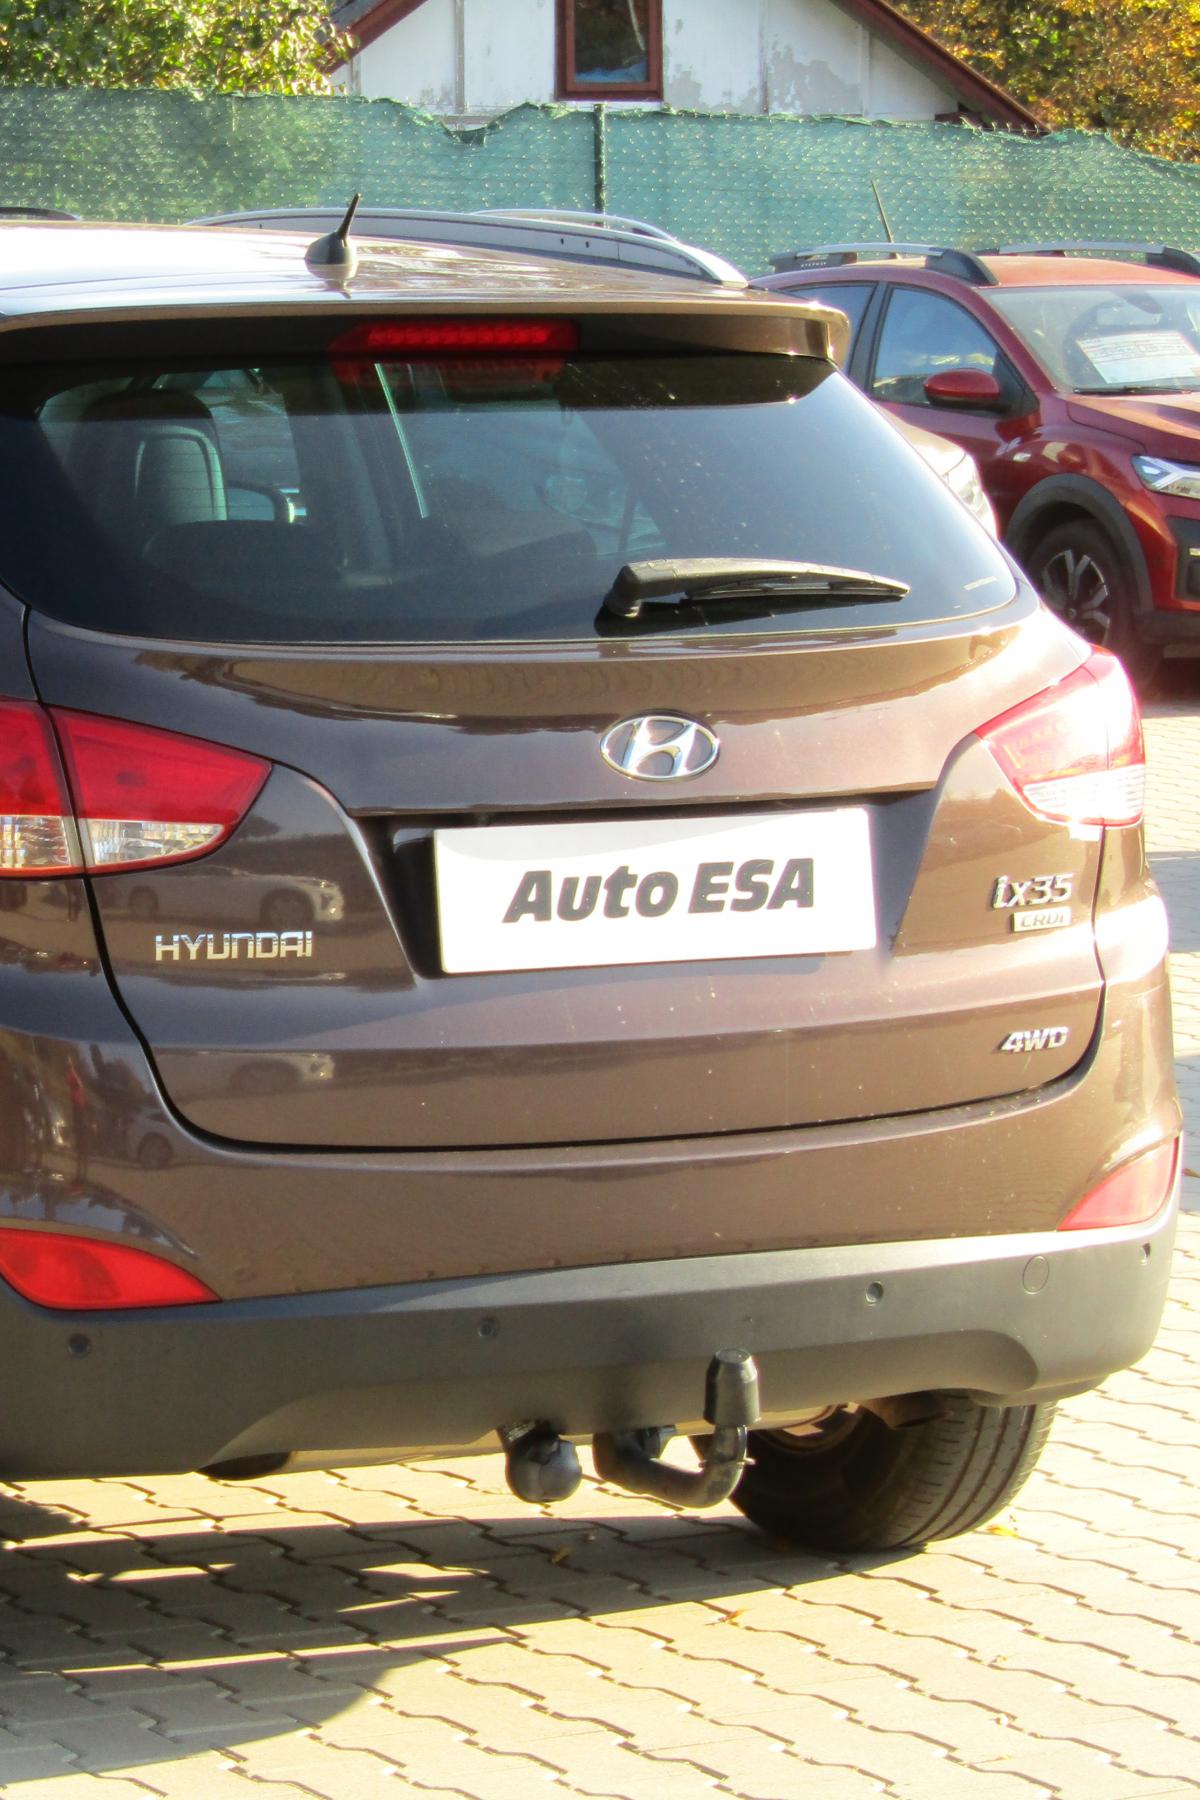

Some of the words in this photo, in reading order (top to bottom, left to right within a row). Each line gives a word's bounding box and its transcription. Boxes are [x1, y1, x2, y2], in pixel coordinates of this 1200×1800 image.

[502, 865, 679, 923] Auto
[688, 857, 814, 914] ESA
[992, 873, 1074, 908] ix35
[155, 931, 313, 961] HYUNDAI
[1000, 1026, 1069, 1052] 4WD
